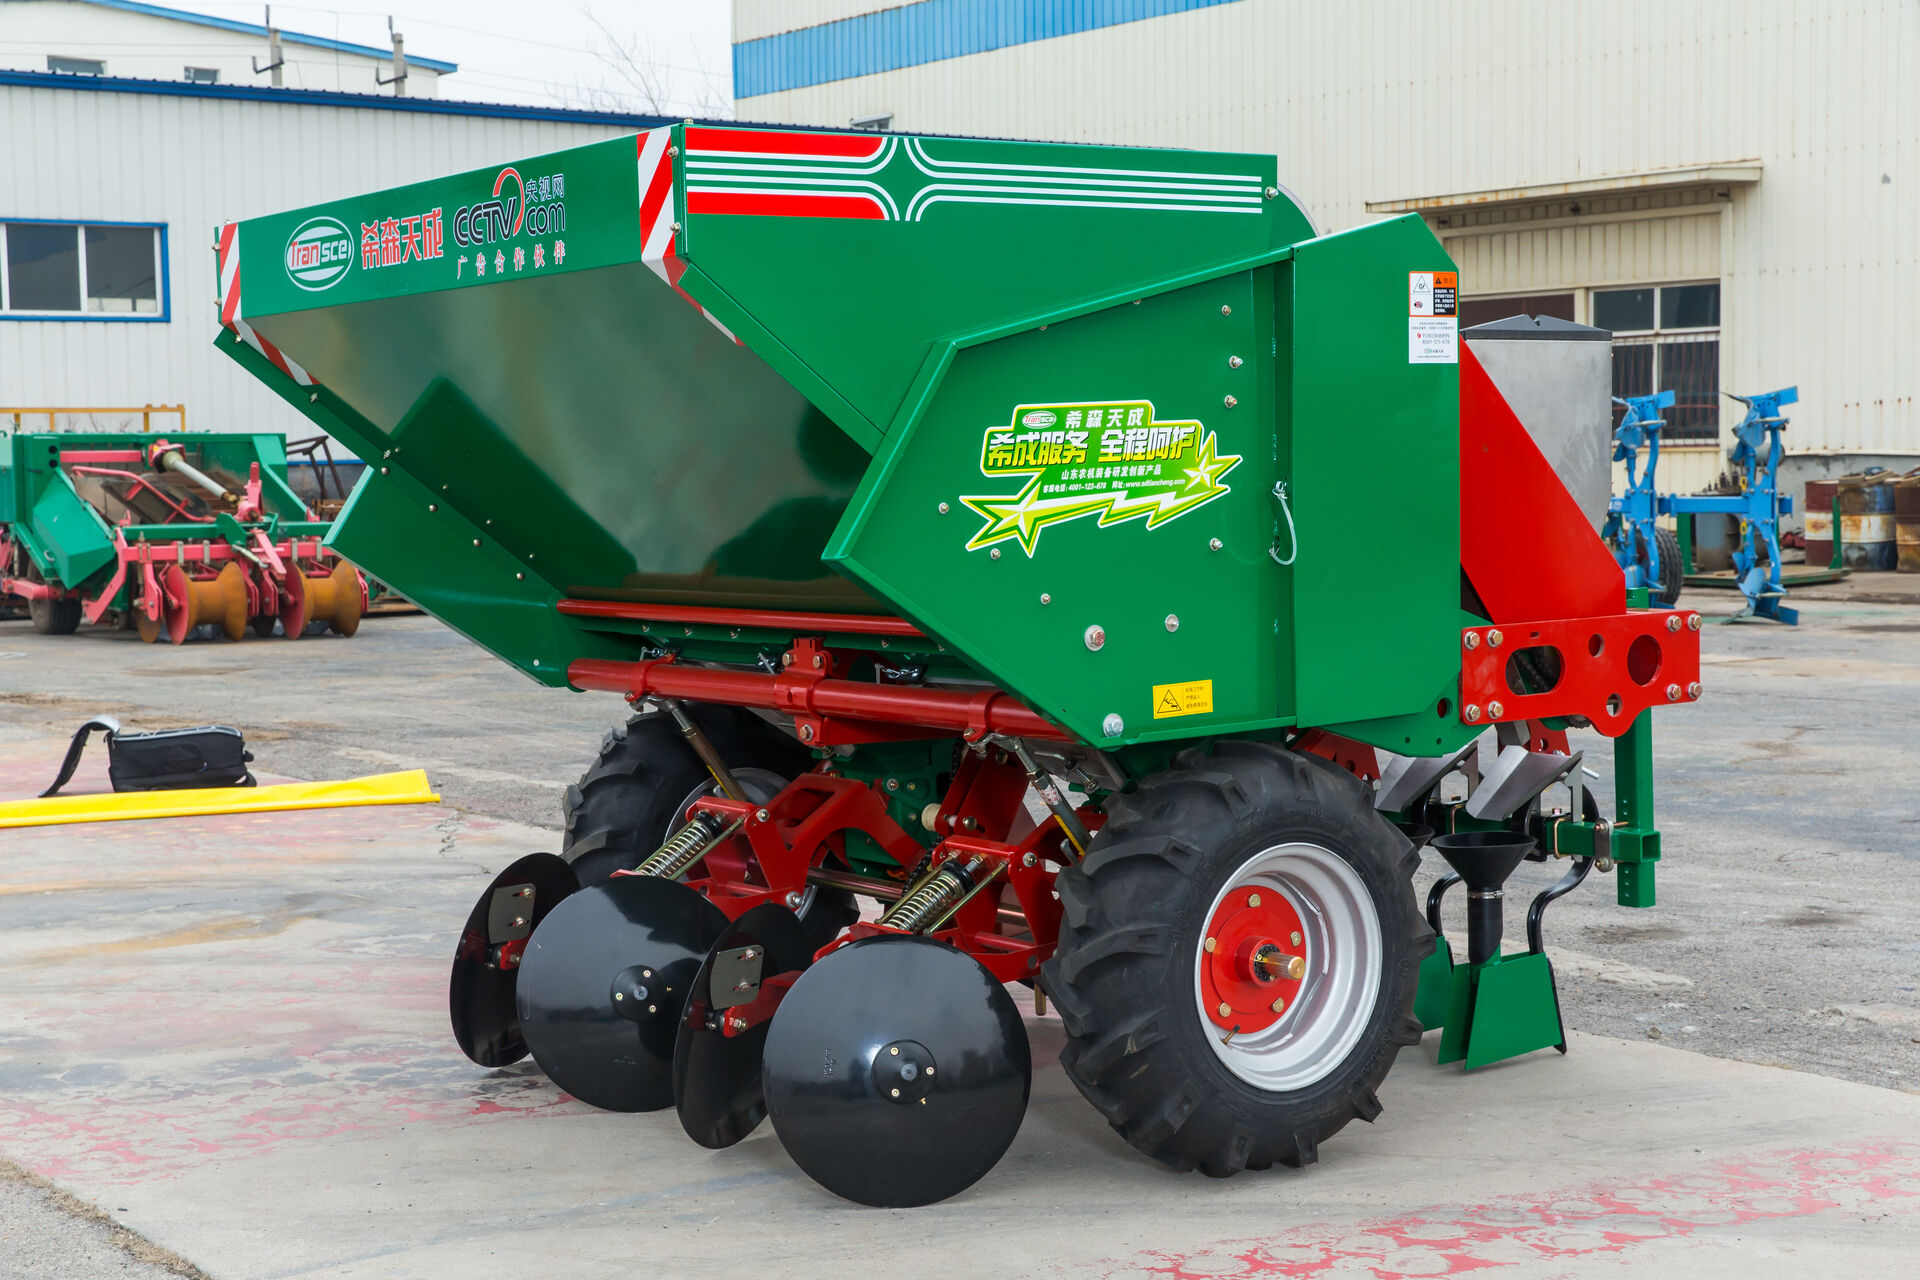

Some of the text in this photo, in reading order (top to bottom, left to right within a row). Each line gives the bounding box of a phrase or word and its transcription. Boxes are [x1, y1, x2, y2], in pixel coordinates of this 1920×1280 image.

[525, 173, 565, 204] 央视网
[361, 207, 444, 270] 希森天成
[453, 197, 517, 247] CCTV
[456, 240, 566, 280] 广告合作伙伴
[1065, 408, 1144, 429] 希森天成
[988, 426, 1196, 467] 希成服务 全程呵护
[1061, 464, 1161, 480] 山东农机装备研发创新产品
